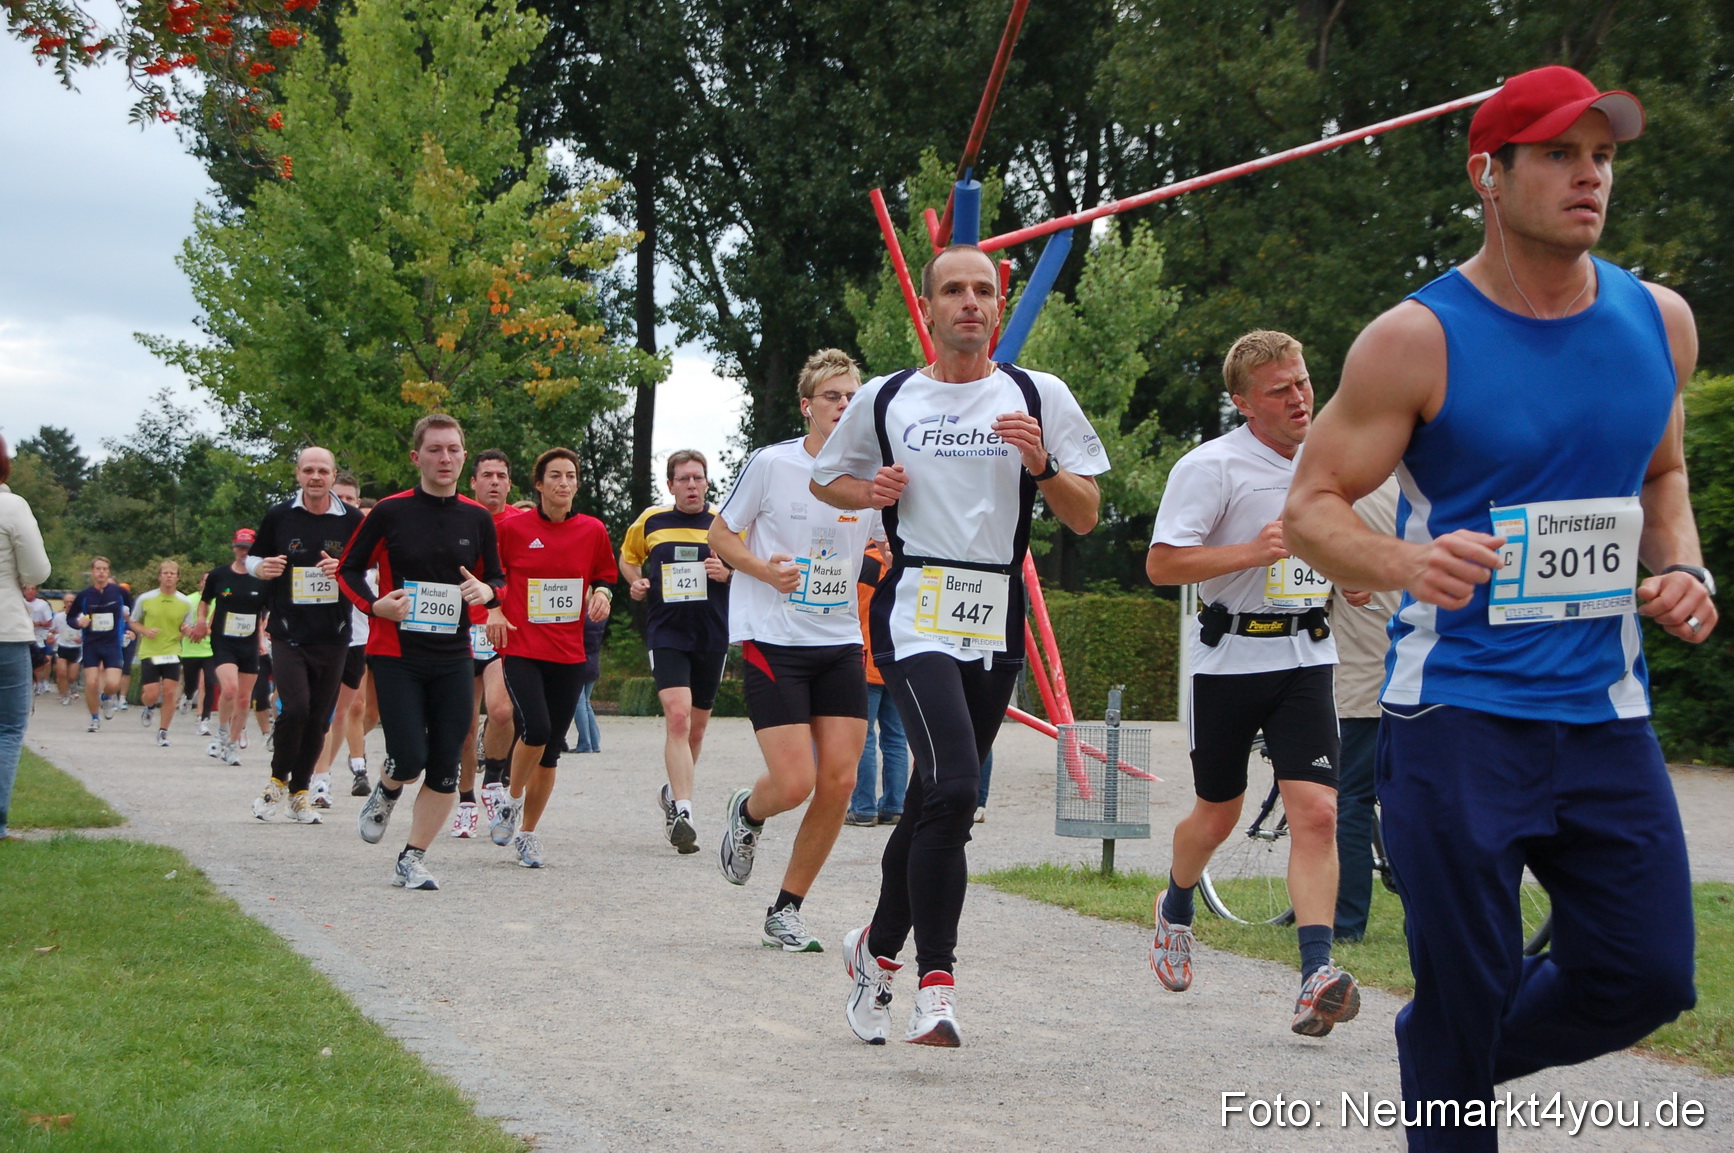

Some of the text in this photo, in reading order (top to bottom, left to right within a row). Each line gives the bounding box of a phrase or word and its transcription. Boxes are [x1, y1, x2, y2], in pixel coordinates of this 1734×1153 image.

[934, 449, 1008, 457] Automobile
[1538, 514, 1616, 536] Christian
[1504, 551, 1513, 566] C
[1537, 542, 1620, 579] 3016
[813, 564, 842, 576] Markus
[310, 581, 331, 592] 125
[543, 583, 567, 592] Andrea
[677, 577, 698, 588] 421
[812, 580, 847, 595] 3445
[946, 575, 982, 593] Bernd
[420, 587, 448, 598] Michael
[549, 596, 573, 608] 165
[921, 595, 928, 607] C
[420, 601, 455, 616] 2906
[951, 601, 994, 625] 447
[1249, 619, 1284, 630] PowerBar
[971, 637, 1004, 647] PFLEIDERER
